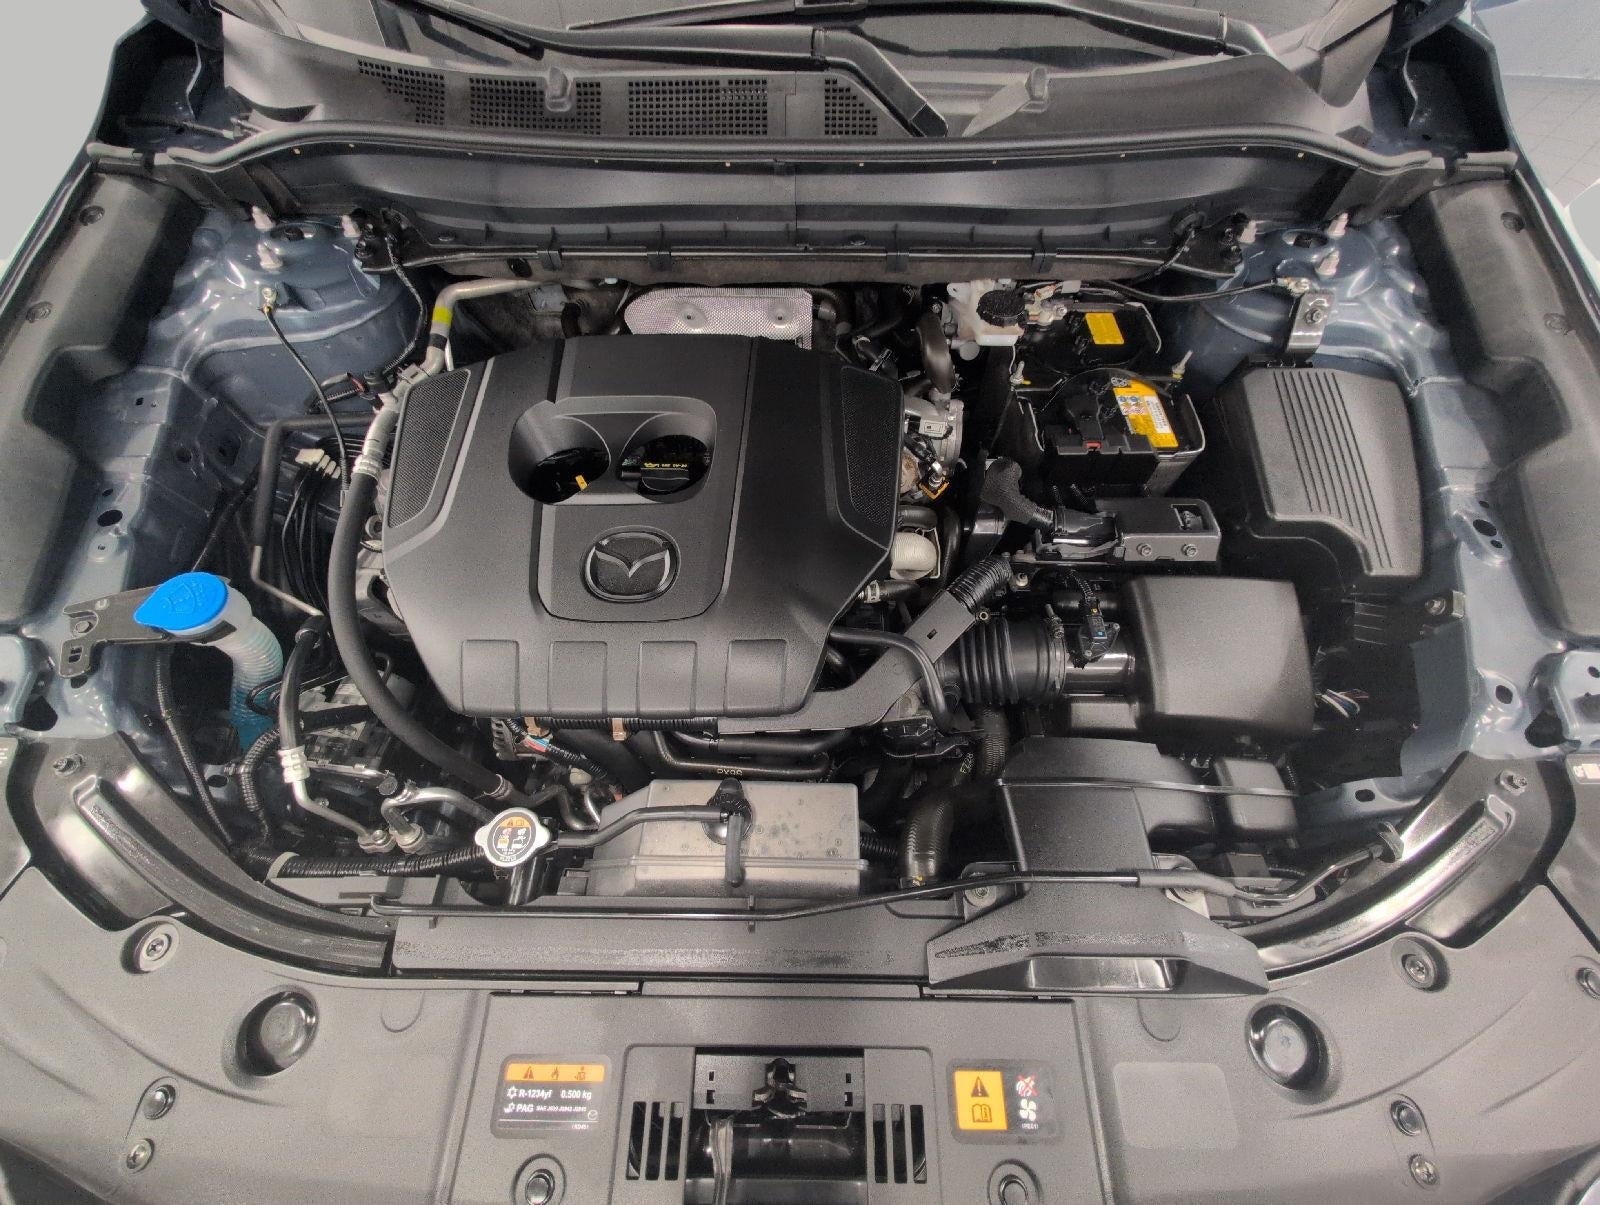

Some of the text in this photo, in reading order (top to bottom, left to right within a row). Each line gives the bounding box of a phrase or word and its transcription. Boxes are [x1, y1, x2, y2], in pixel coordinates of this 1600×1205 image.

[518, 1089, 552, 1100] R-1234yf
[582, 1089, 592, 1101] kg
[516, 1103, 534, 1113] PAG
